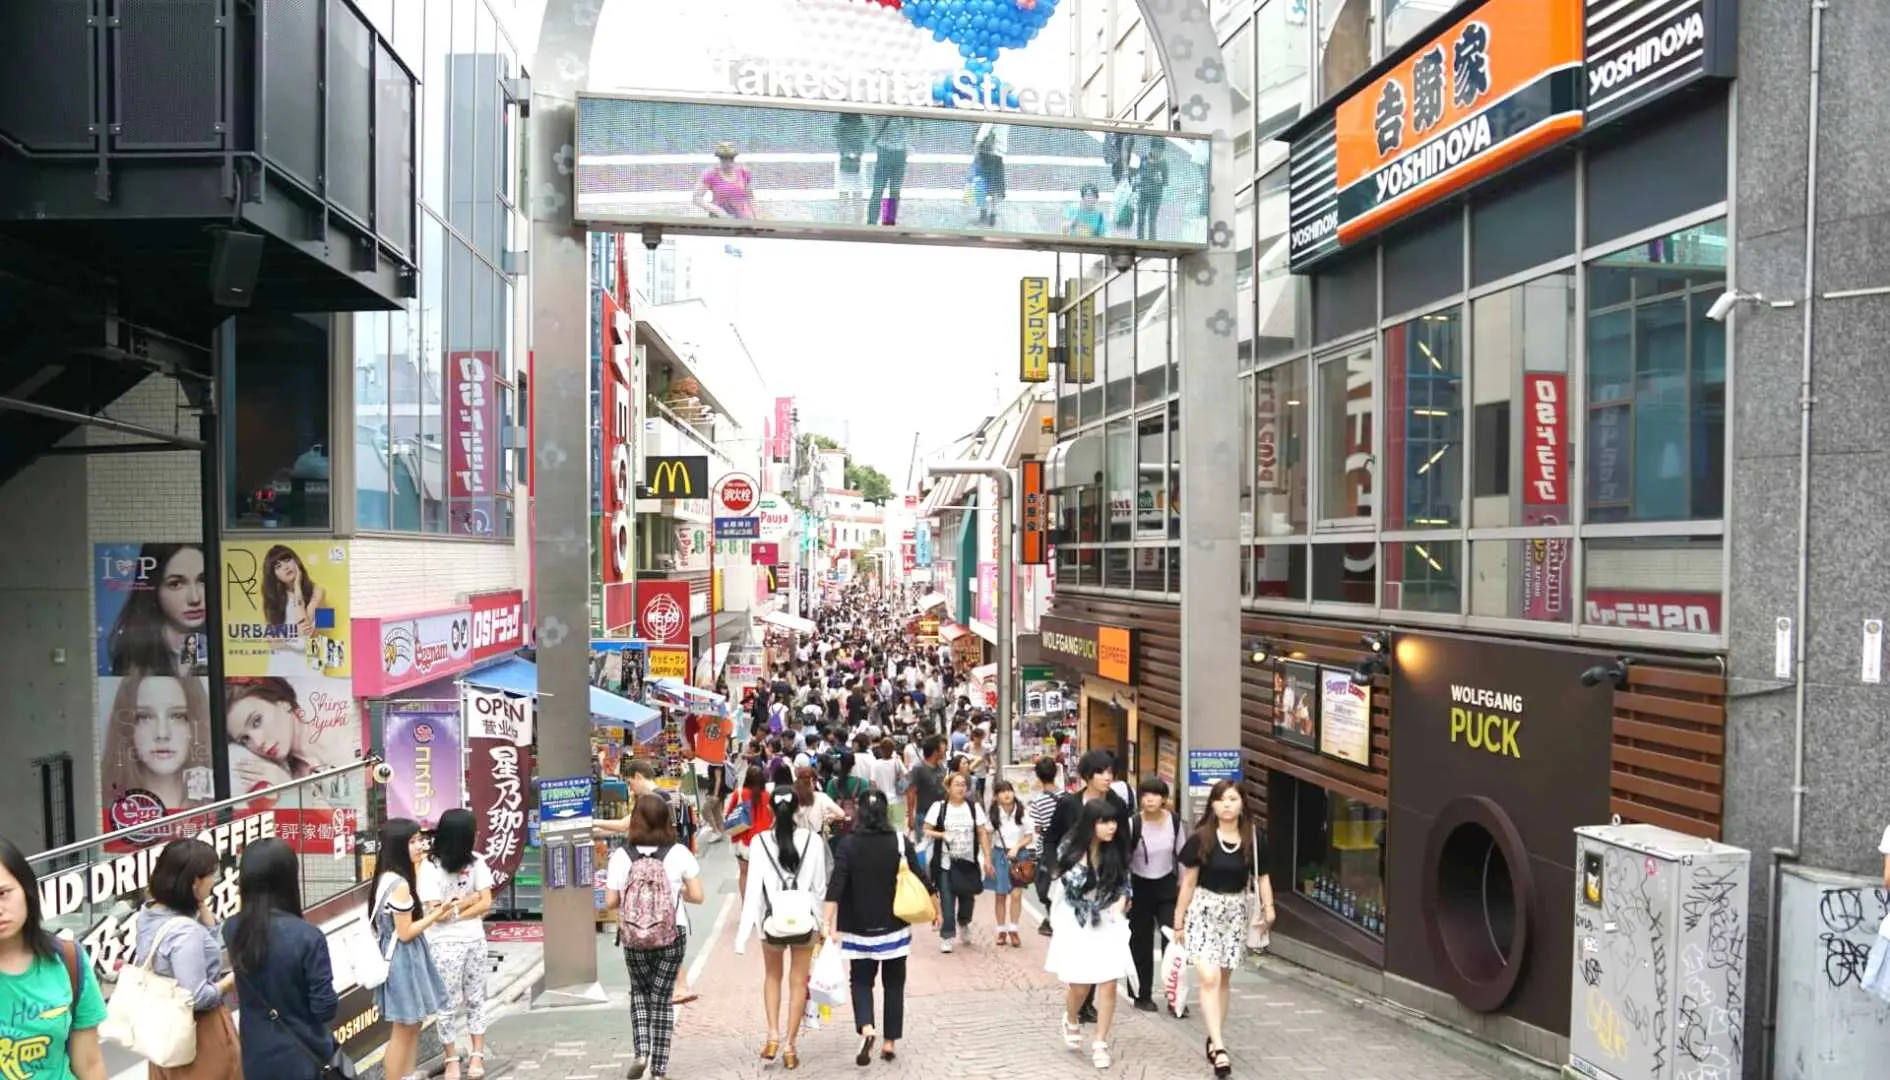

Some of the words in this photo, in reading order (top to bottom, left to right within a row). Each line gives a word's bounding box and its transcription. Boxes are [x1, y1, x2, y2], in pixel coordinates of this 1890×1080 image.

[1589, 12, 1705, 96] YOSHINOYA
[1376, 114, 1492, 203] YOSHINOYA
[1027, 280, 1045, 368] コインロッカー
[228, 623, 299, 638] URBAN!!
[475, 696, 525, 723] OPEN
[1451, 684, 1523, 713] WOLFGANG
[1450, 707, 1521, 758] PUCK
